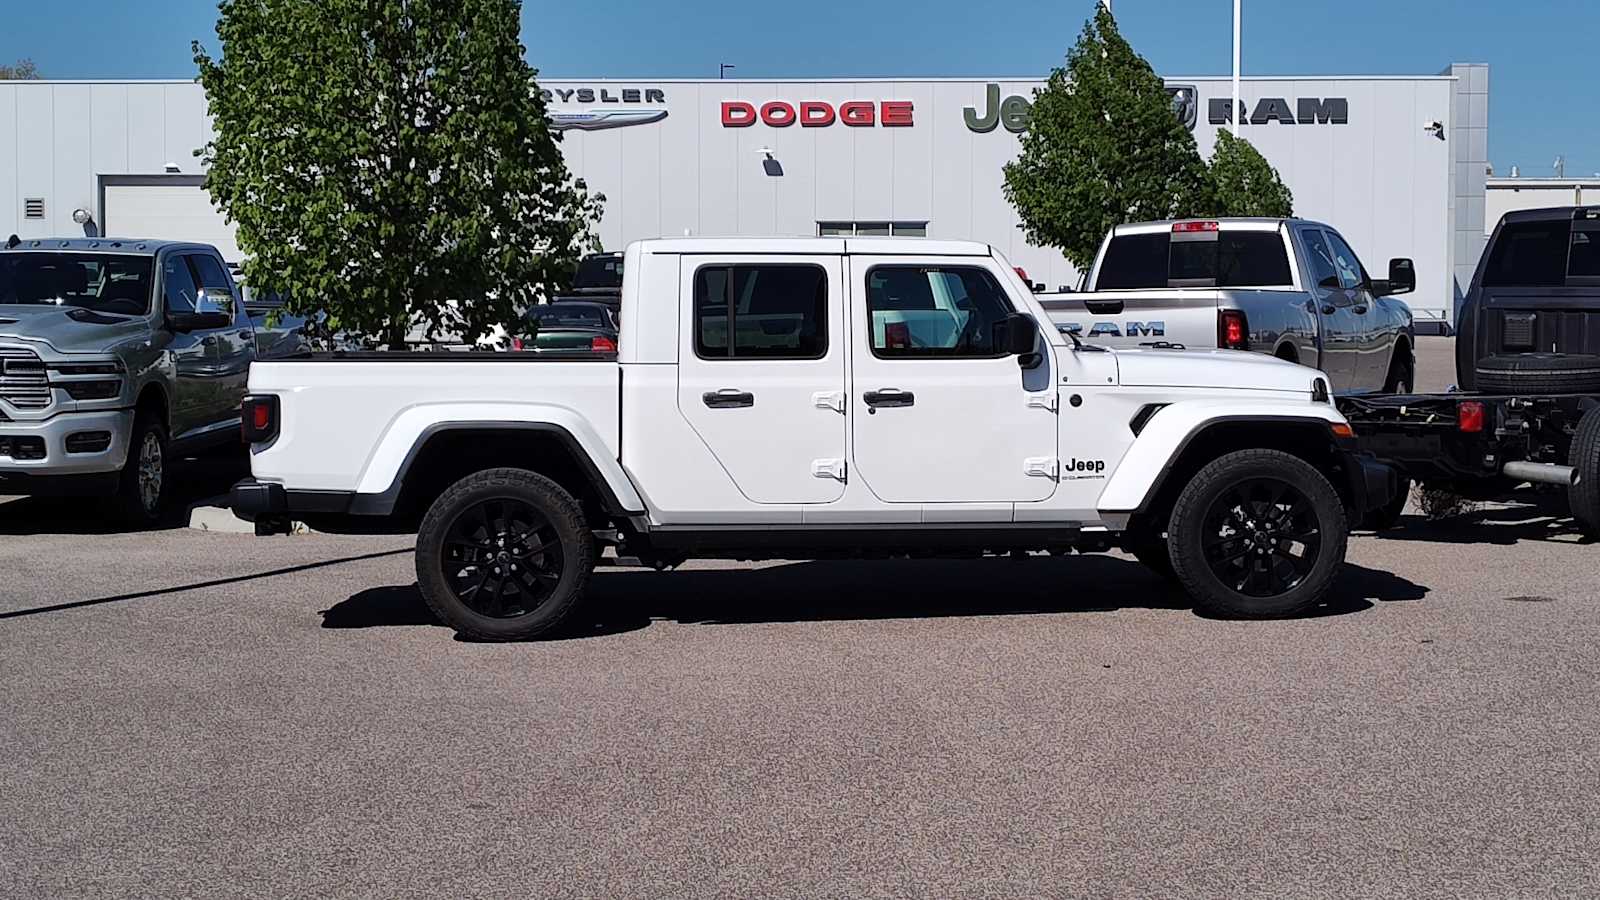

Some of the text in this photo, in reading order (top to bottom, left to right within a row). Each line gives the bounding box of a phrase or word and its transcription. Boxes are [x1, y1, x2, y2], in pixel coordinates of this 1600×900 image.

[540, 88, 665, 103] RYSLER
[721, 101, 914, 128] DODGE
[963, 83, 1032, 133] Je
[1208, 98, 1348, 125] RAM
[1055, 321, 1164, 337] RAM
[1065, 458, 1105, 473] Jeep
